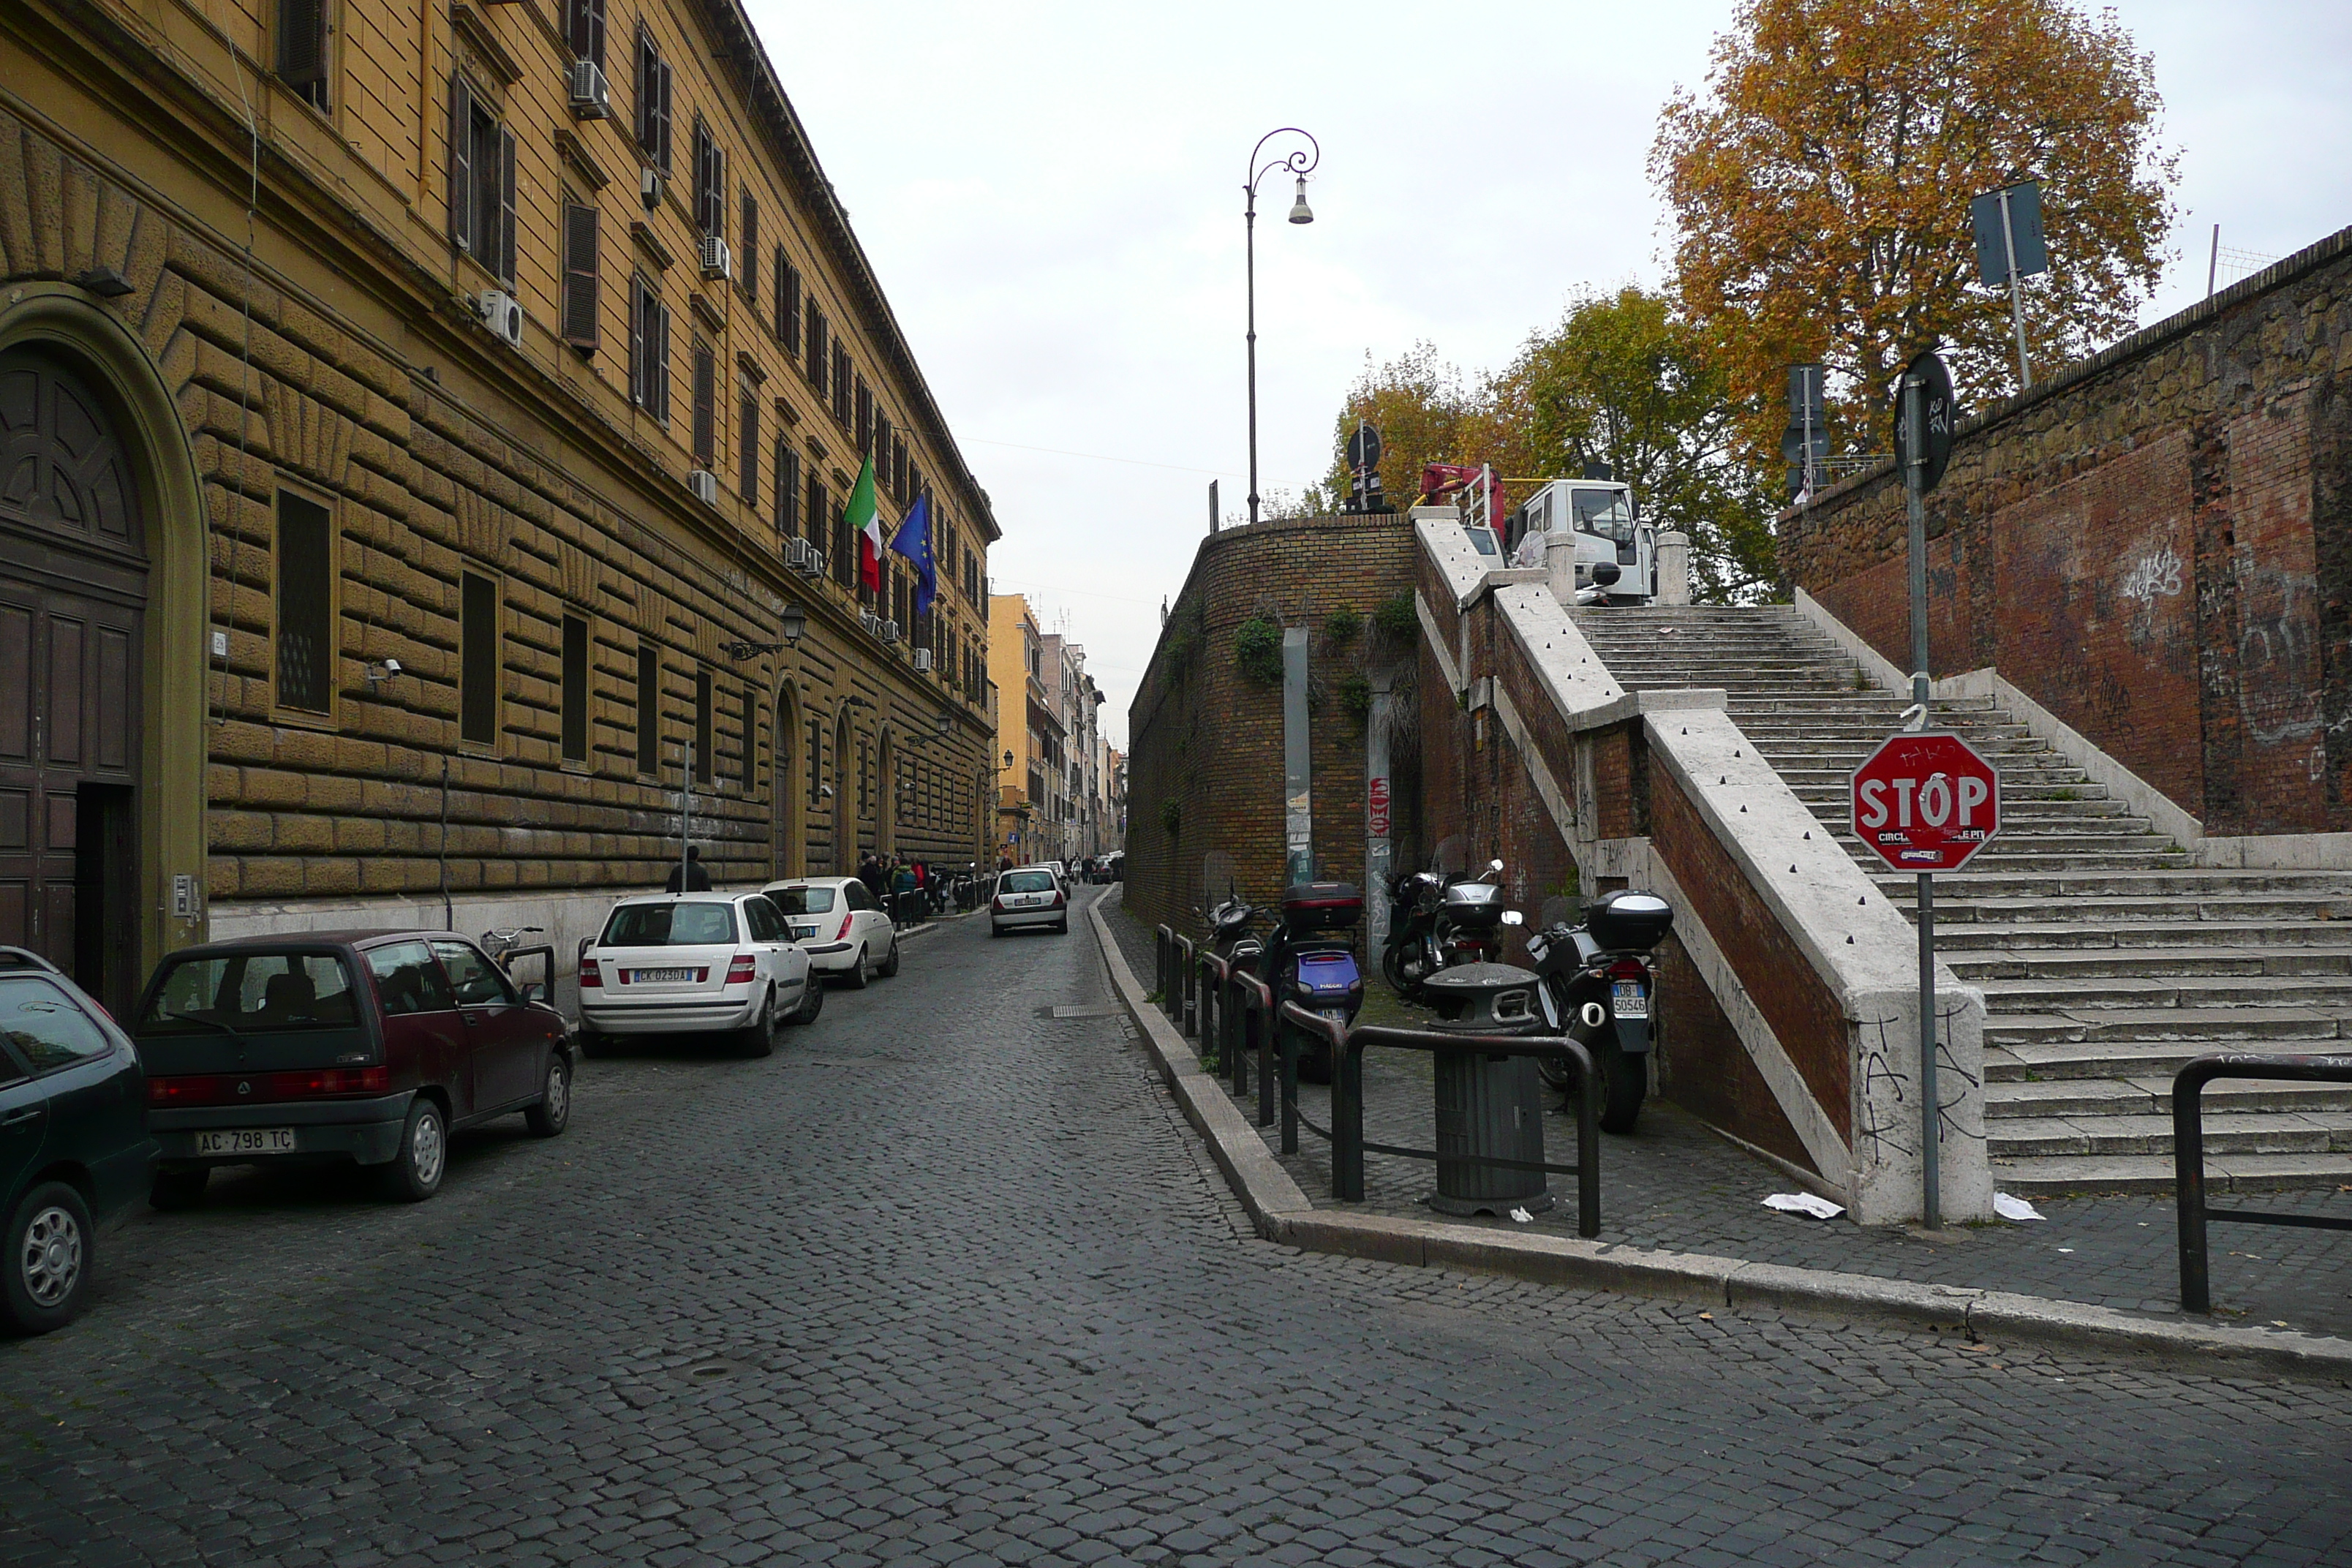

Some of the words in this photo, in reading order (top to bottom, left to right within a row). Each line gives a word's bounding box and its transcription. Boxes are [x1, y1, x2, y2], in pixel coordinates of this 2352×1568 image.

[1860, 776, 1988, 828] STOP
[640, 970, 654, 981] CK
[655, 969, 686, 981] 023DA
[1619, 984, 1632, 996] DB
[1615, 999, 1646, 1011] 50546
[201, 1134, 222, 1151] AC
[231, 1132, 264, 1152] 798
[270, 1131, 291, 1148] TC
